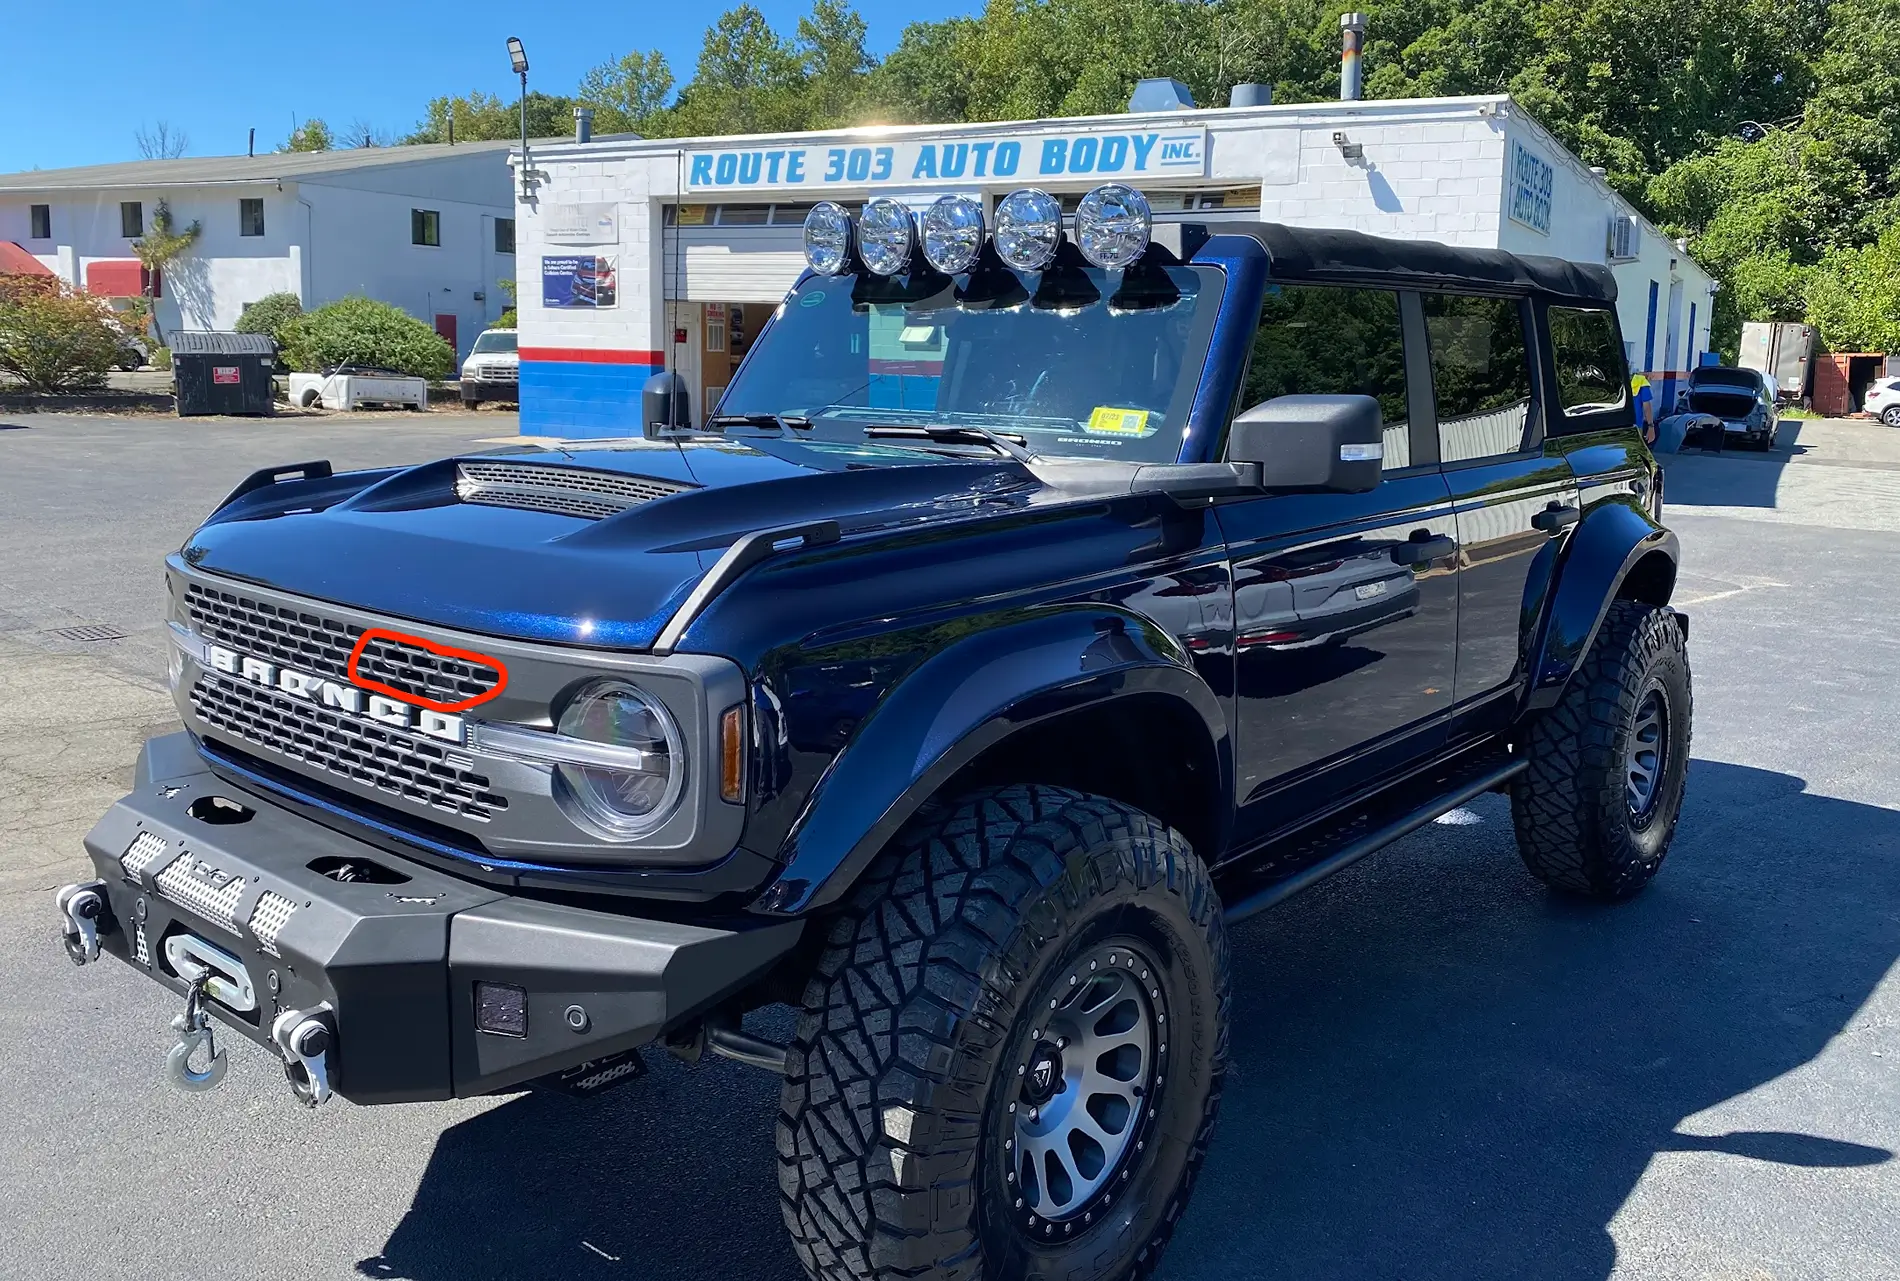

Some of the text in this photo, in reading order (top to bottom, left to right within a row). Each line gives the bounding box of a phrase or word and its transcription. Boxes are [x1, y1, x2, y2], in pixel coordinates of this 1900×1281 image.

[690, 134, 1200, 185] ROUTE 303 AUTO BODY INC.
[1516, 146, 1553, 198] ROUTE 303
[1514, 184, 1533, 222] AUTO
[211, 645, 465, 742] BRONCO
